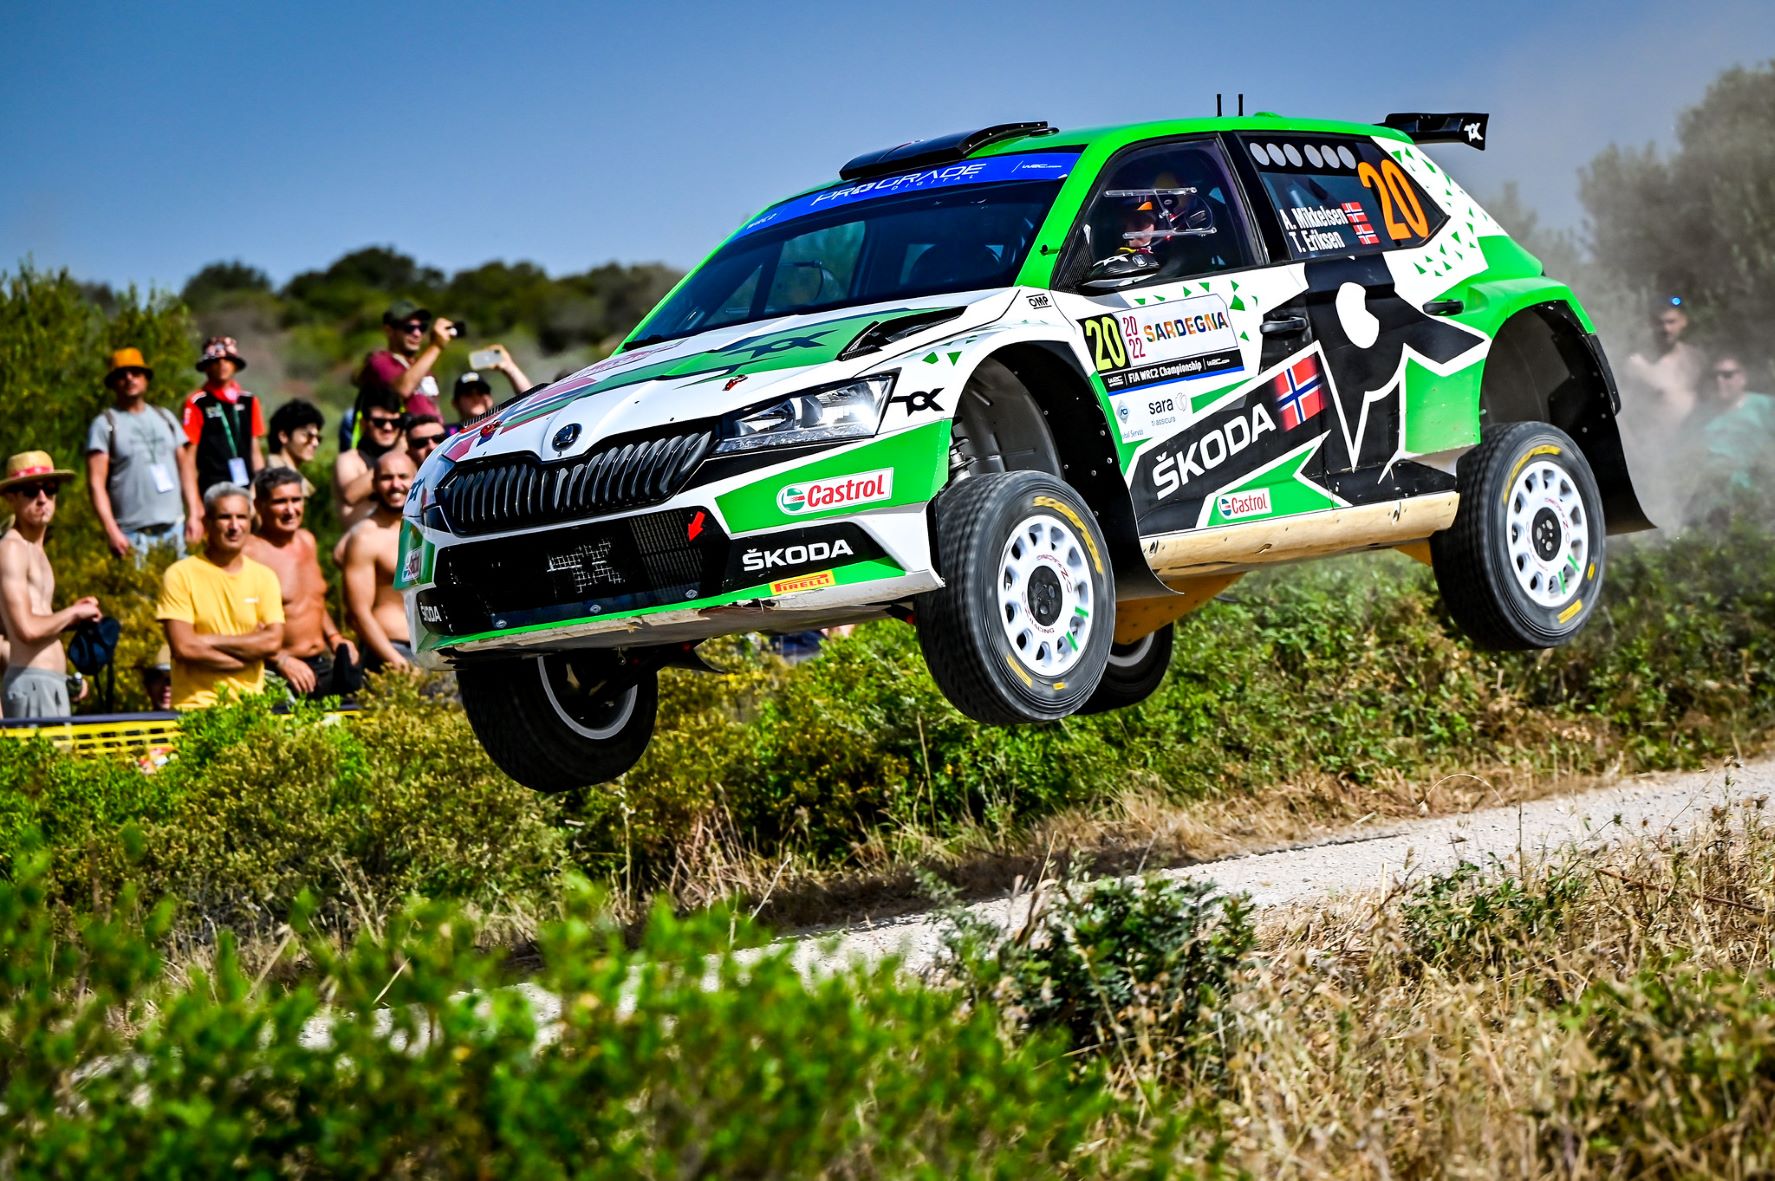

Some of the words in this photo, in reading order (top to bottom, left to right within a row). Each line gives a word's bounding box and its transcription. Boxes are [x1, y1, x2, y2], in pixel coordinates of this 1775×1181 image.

[810, 163, 987, 206] PROGRADE
[1358, 159, 1429, 240] 20
[1280, 209, 1297, 230] A.
[1291, 205, 1349, 229] Mikkelsen
[1289, 231, 1306, 253] T.
[1301, 229, 1346, 251] Eriksen
[1028, 296, 1048, 307] OMP
[1123, 316, 1138, 337] 20
[1143, 312, 1229, 343] SARDEGNA
[1085, 316, 1126, 371] 20
[1129, 337, 1146, 359] 22
[1128, 372, 1141, 384] FIA
[1140, 368, 1160, 382] WRC2
[1159, 360, 1203, 377] Championship
[1148, 398, 1174, 415] sara
[1152, 402, 1277, 501] ŠKODA
[807, 474, 884, 508] Castrol
[1231, 493, 1268, 514] Castrol
[742, 539, 854, 572] ŠKODA
[774, 573, 830, 593] PIRELLI
